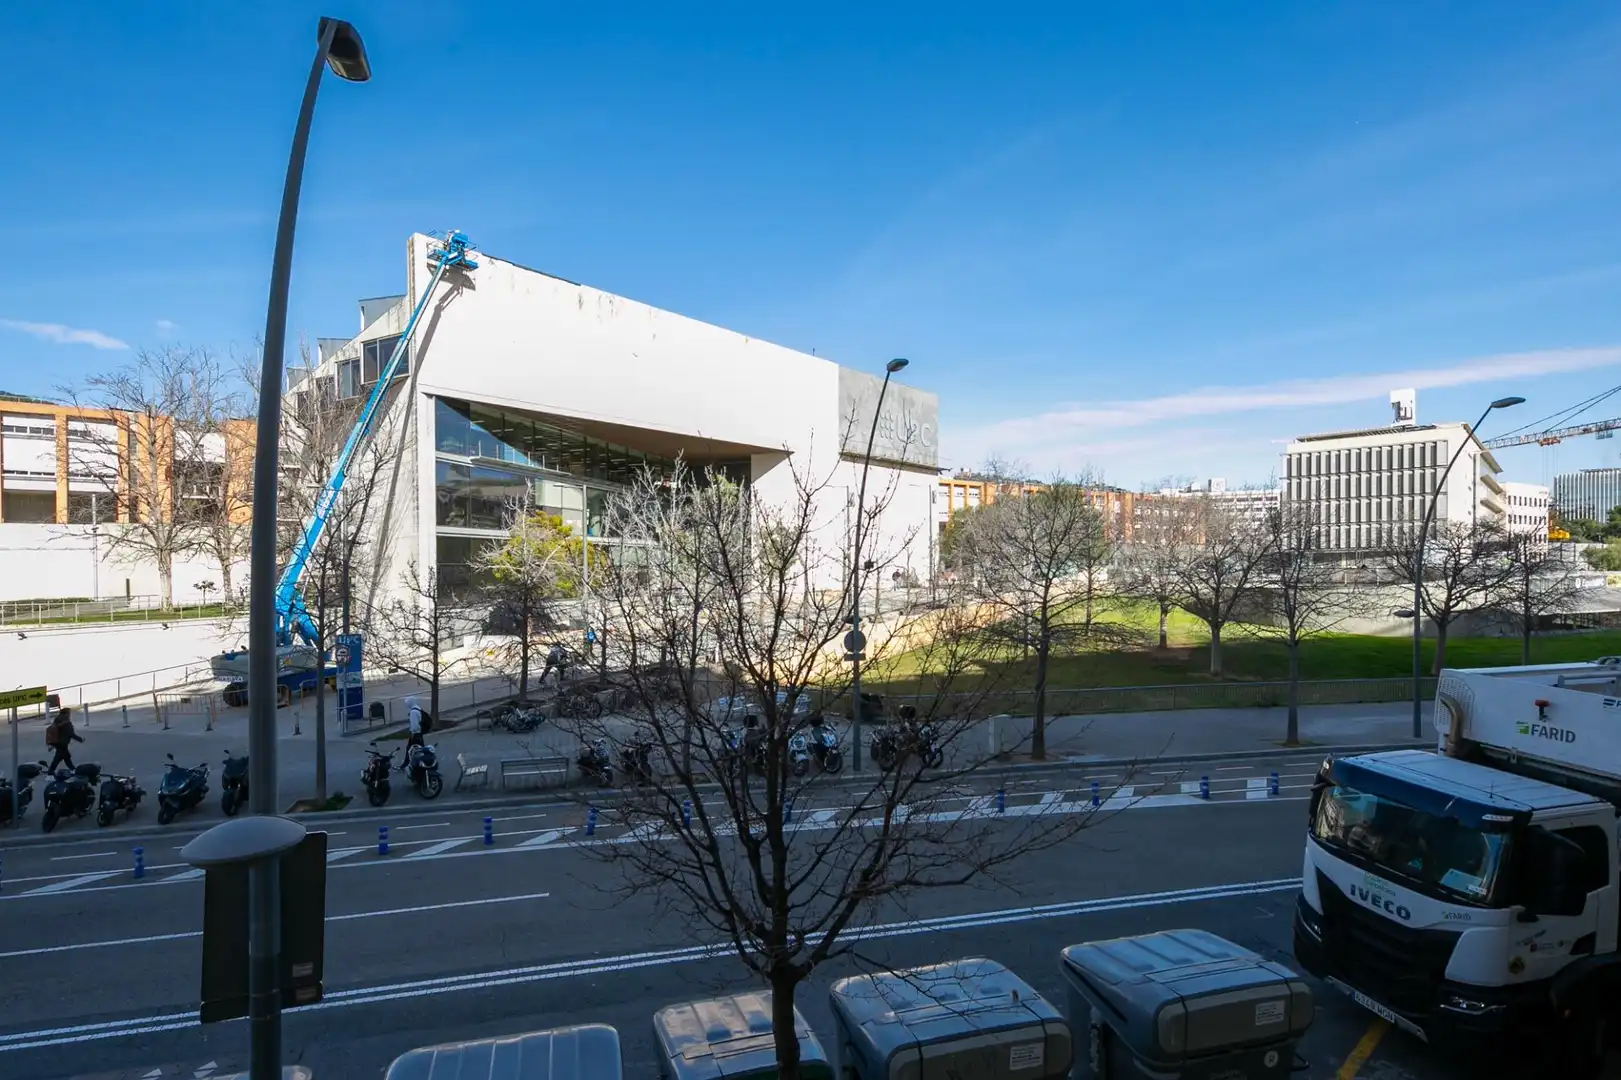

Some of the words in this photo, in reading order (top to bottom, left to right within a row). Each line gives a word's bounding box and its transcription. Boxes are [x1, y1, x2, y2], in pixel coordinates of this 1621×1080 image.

[339, 636, 360, 645] UPC
[12, 694, 28, 703] UPC
[1531, 723, 1576, 743] FARID
[1350, 884, 1411, 920] IVECO
[1448, 912, 1471, 921] FARID
